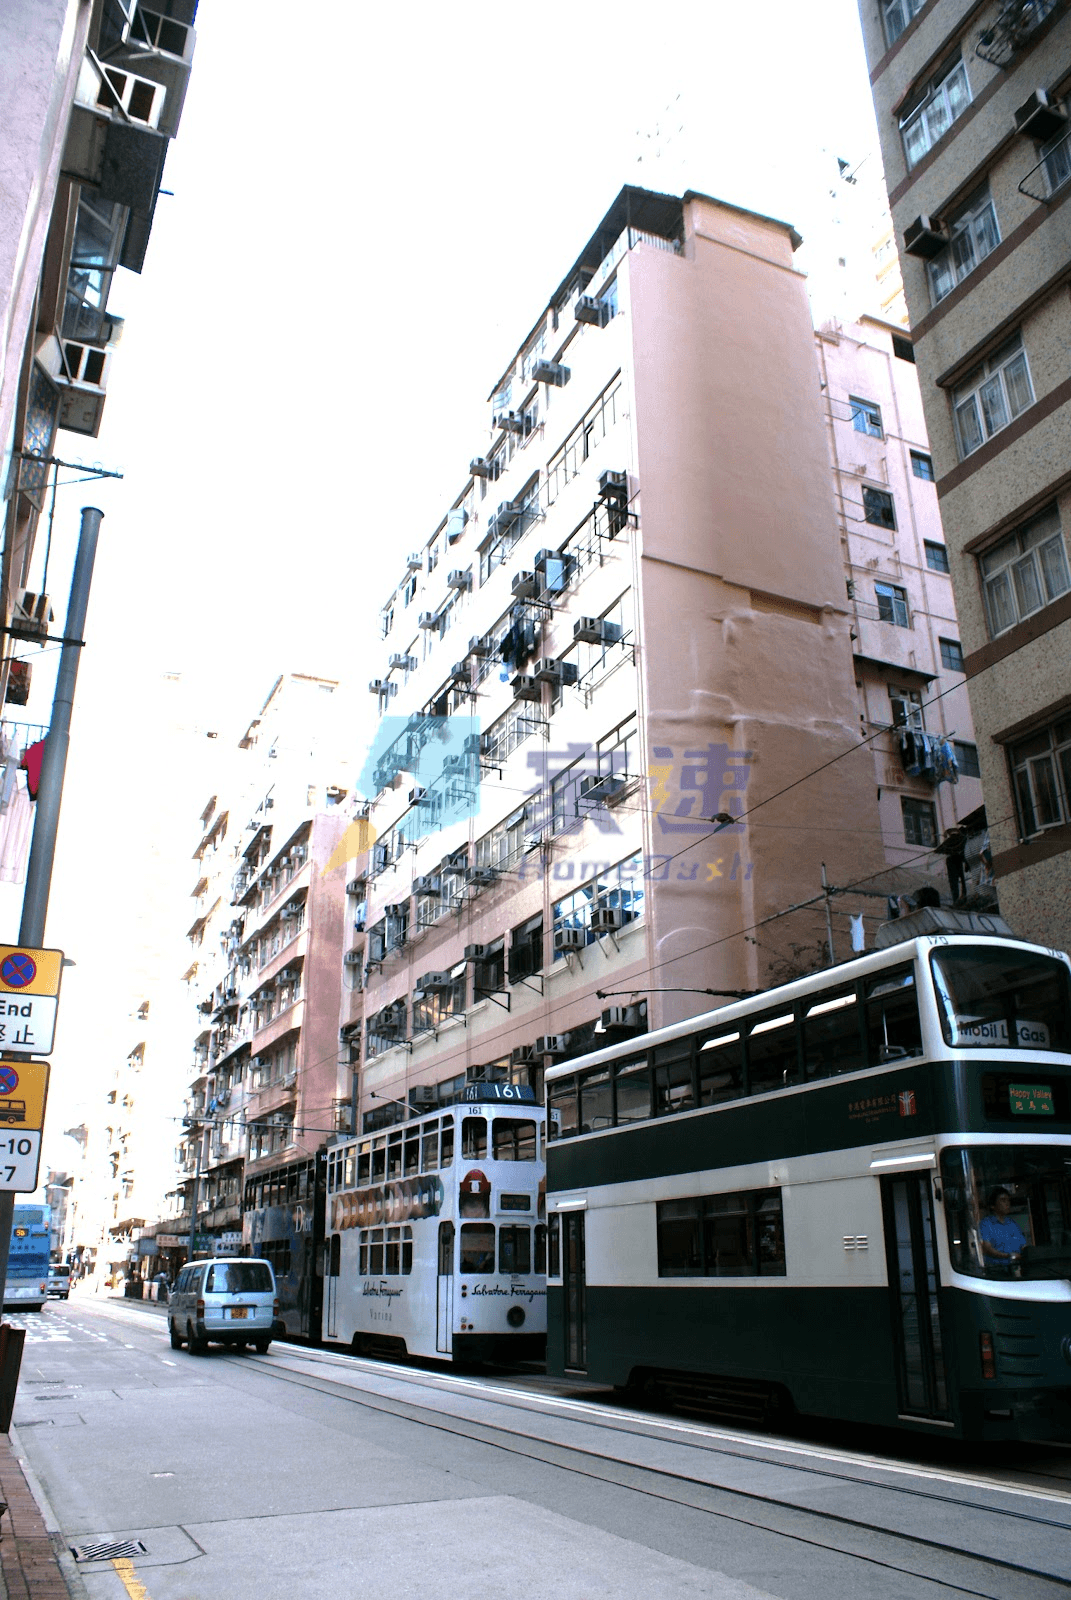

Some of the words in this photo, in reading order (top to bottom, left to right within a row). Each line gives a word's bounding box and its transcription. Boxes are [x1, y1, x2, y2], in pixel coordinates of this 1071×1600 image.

[926, 936, 949, 945] 170
[0, 1024, 35, 1045] 止
[1001, 1024, 1046, 1043] L-Gas
[494, 1084, 522, 1099] 161
[1010, 1088, 1030, 1099] Happy
[1032, 1089, 1052, 1100] Valley
[468, 1107, 482, 1115] 161
[295, 1205, 313, 1233] Dior
[471, 1283, 510, 1296] Salvatore
[510, 1283, 547, 1303] Ferragam
